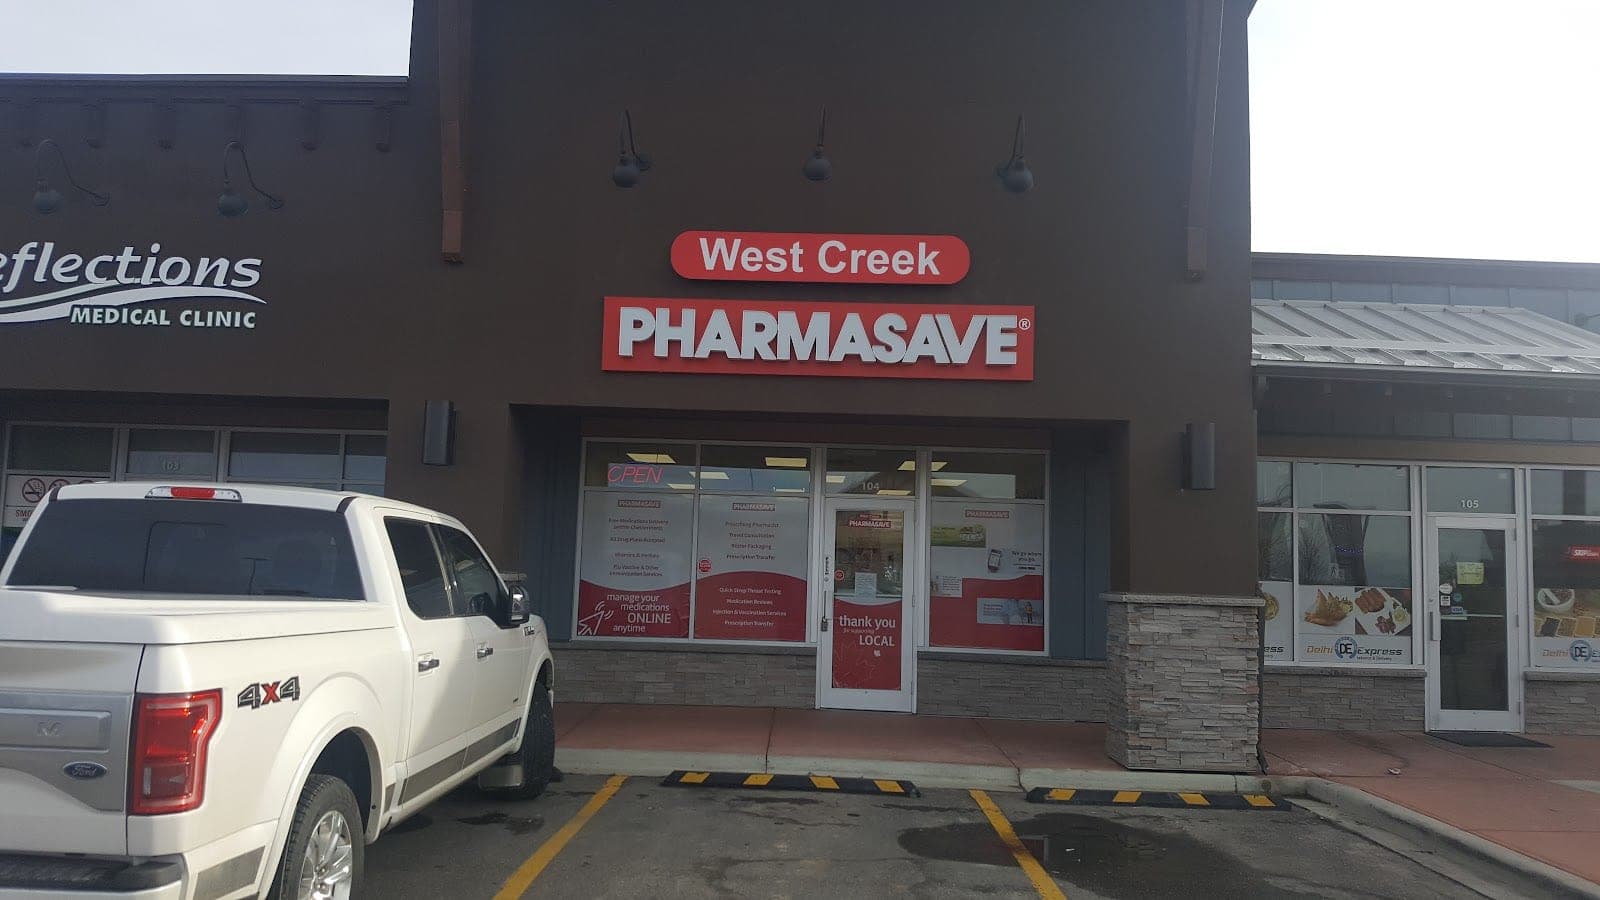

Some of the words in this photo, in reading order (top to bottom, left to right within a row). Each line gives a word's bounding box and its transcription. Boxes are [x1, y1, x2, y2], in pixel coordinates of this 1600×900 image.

[699, 238, 804, 273] West
[818, 240, 940, 275] Creek
[70, 307, 171, 325] MEDICAL
[180, 310, 256, 328] CLINIC
[607, 465, 664, 484] OPEN
[862, 482, 880, 490] 104
[1460, 500, 1480, 508] 105
[849, 520, 890, 528] PHARMASAVE
[607, 594, 640, 604] manage
[641, 594, 660, 604] your
[620, 603, 670, 612] medications
[627, 613, 672, 624] ONLINE
[839, 614, 873, 627] thank
[874, 618, 896, 631] you
[612, 623, 646, 634] anytime
[859, 634, 896, 646] LOCAL
[1306, 645, 1334, 656] Delhi
[1339, 643, 1353, 655] DE
[1357, 646, 1403, 657] Express
[1574, 646, 1588, 658] DE
[71, 766, 98, 779] Ford
